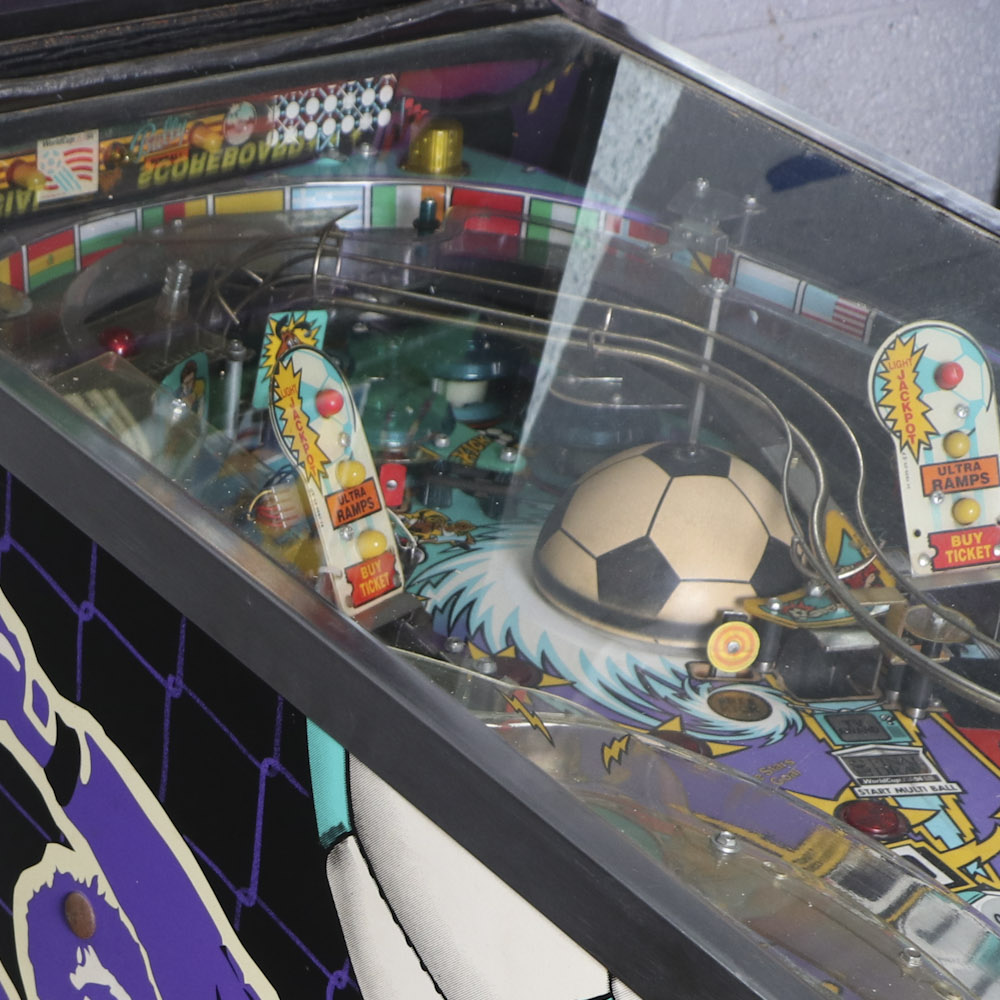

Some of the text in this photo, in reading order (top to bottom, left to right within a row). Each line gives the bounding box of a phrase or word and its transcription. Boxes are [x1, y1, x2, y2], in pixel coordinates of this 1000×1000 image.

[888, 357, 915, 371] LIGHT
[282, 384, 297, 398] LIGHT
[897, 371, 918, 445] JACKPOT
[290, 397, 317, 477] JACKPOT
[938, 461, 982, 476] ULTRA
[932, 472, 991, 492] RAMPS
[339, 486, 367, 506] ULTRA
[337, 497, 375, 522] RAMPS
[951, 531, 984, 548] BUY
[945, 544, 992, 564] TICKET
[360, 560, 382, 580] BUY
[360, 571, 391, 598] TICKET
[858, 783, 958, 796] START MULTI BALL
